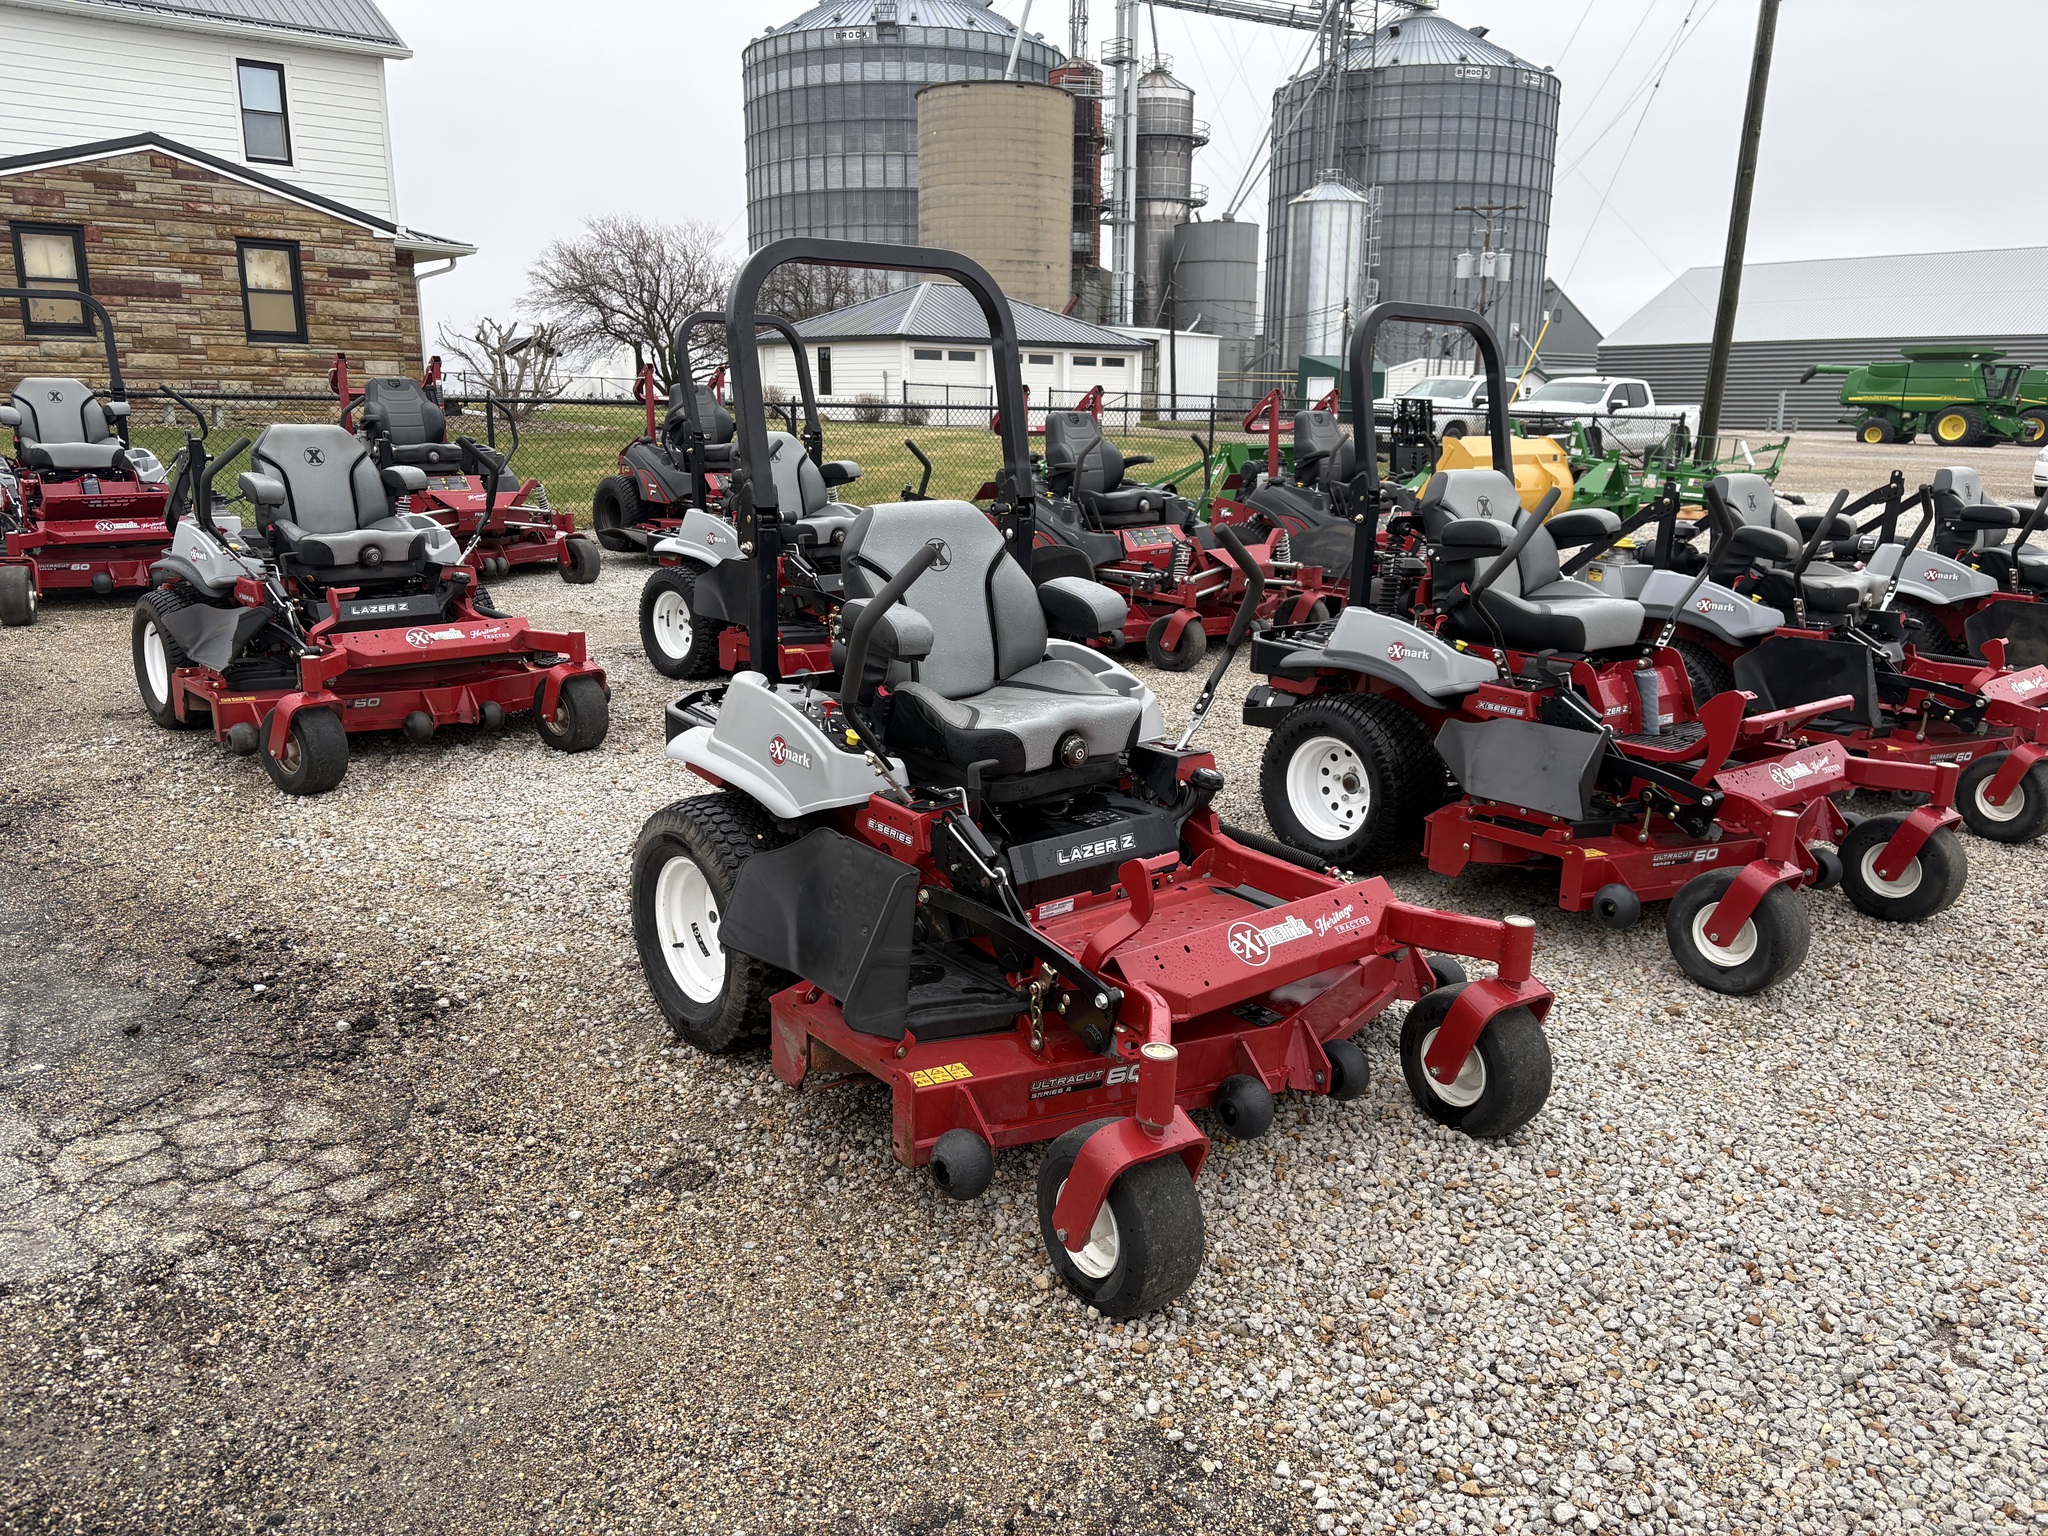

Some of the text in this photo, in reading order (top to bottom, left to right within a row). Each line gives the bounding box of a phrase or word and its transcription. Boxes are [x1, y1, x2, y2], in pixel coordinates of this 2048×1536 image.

[835, 31, 869, 40] BROCK
[71, 563, 90, 571] 60
[351, 602, 408, 615] LAZER Z
[470, 626, 501, 639] Heritage
[484, 632, 511, 640] TRACTOR
[355, 697, 380, 708] 60
[1605, 706, 1622, 717] ZER
[1956, 751, 1973, 762] 60
[1056, 833, 1136, 866] LAZER Z
[1653, 848, 1719, 862] ULTRACUT 60
[1314, 903, 1354, 937] Heritage
[1334, 915, 1372, 935] TRACTOR
[1031, 1068, 1105, 1092] ULTRACUT
[1031, 1087, 1064, 1099] SERIES
